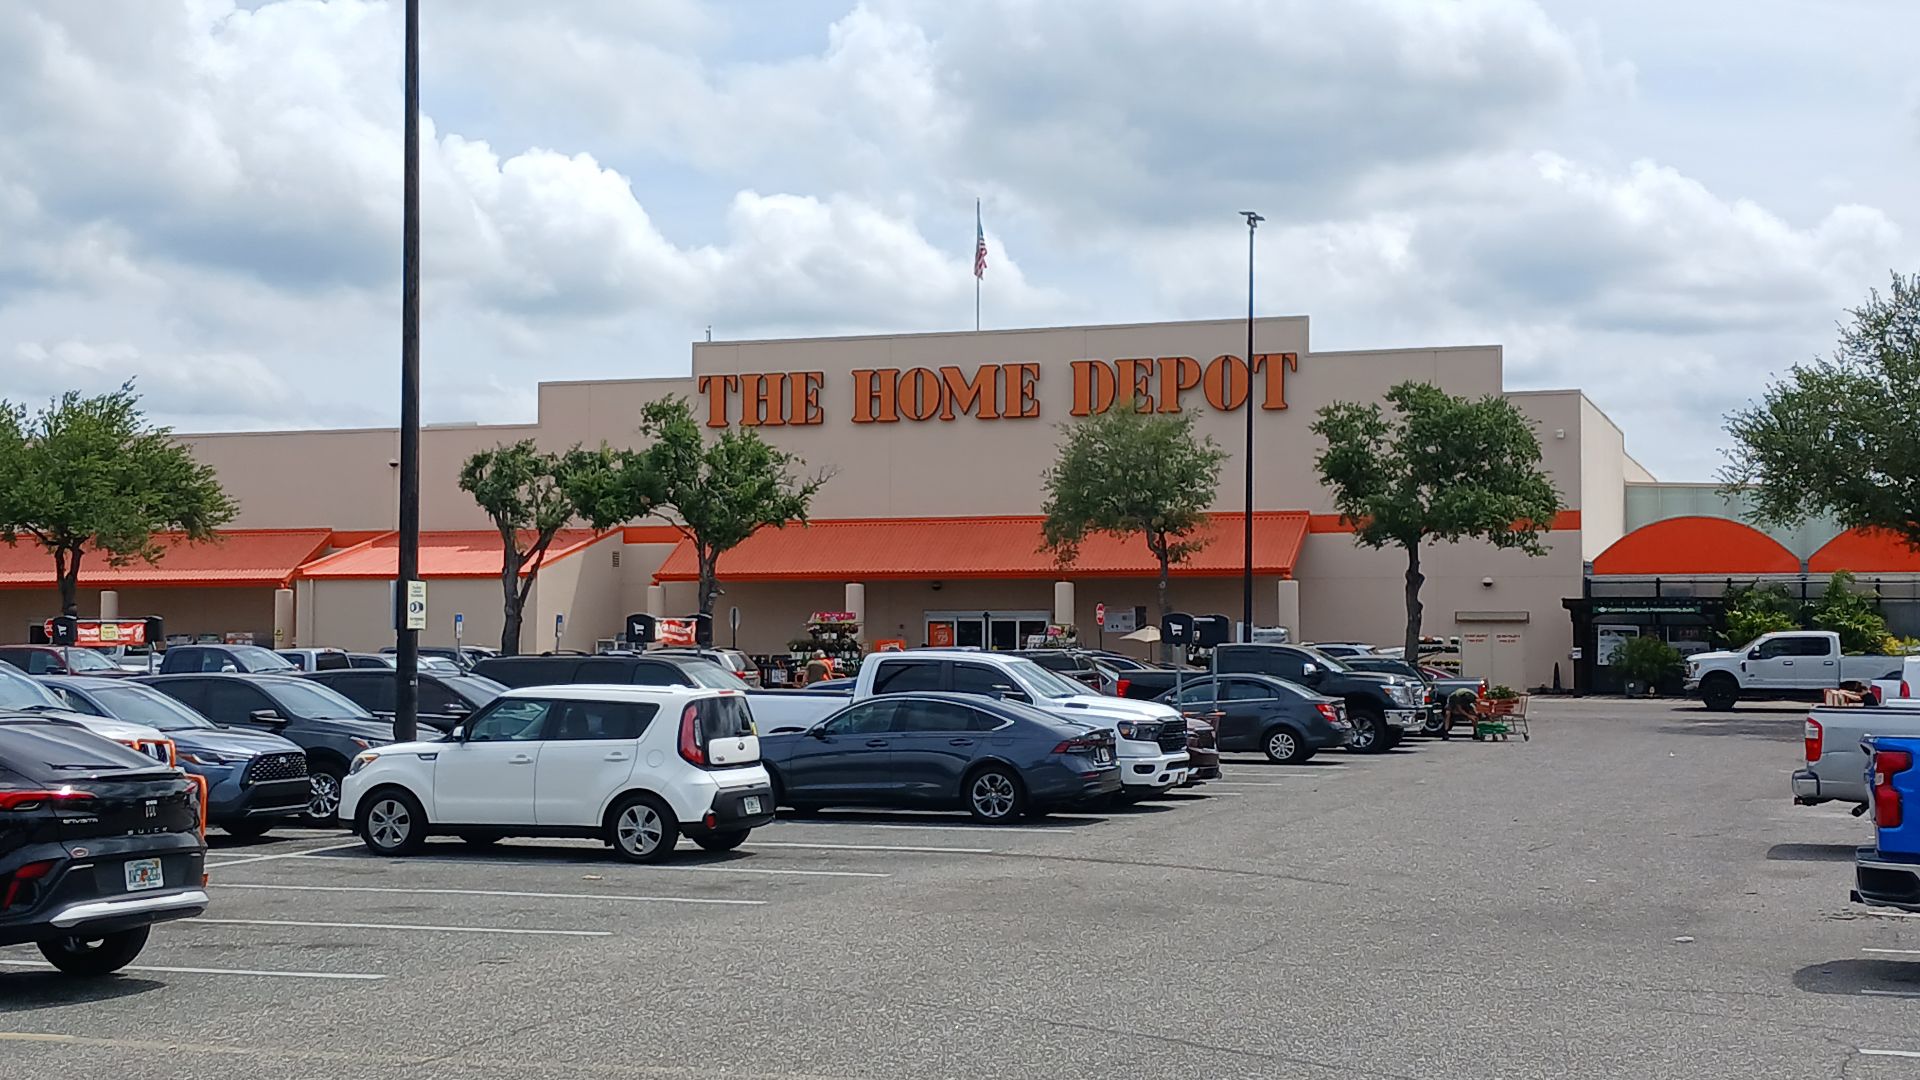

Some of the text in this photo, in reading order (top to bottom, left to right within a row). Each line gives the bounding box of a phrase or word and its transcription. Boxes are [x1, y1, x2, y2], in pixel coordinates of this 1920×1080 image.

[698, 352, 1298, 428] THE HOME DEPOT
